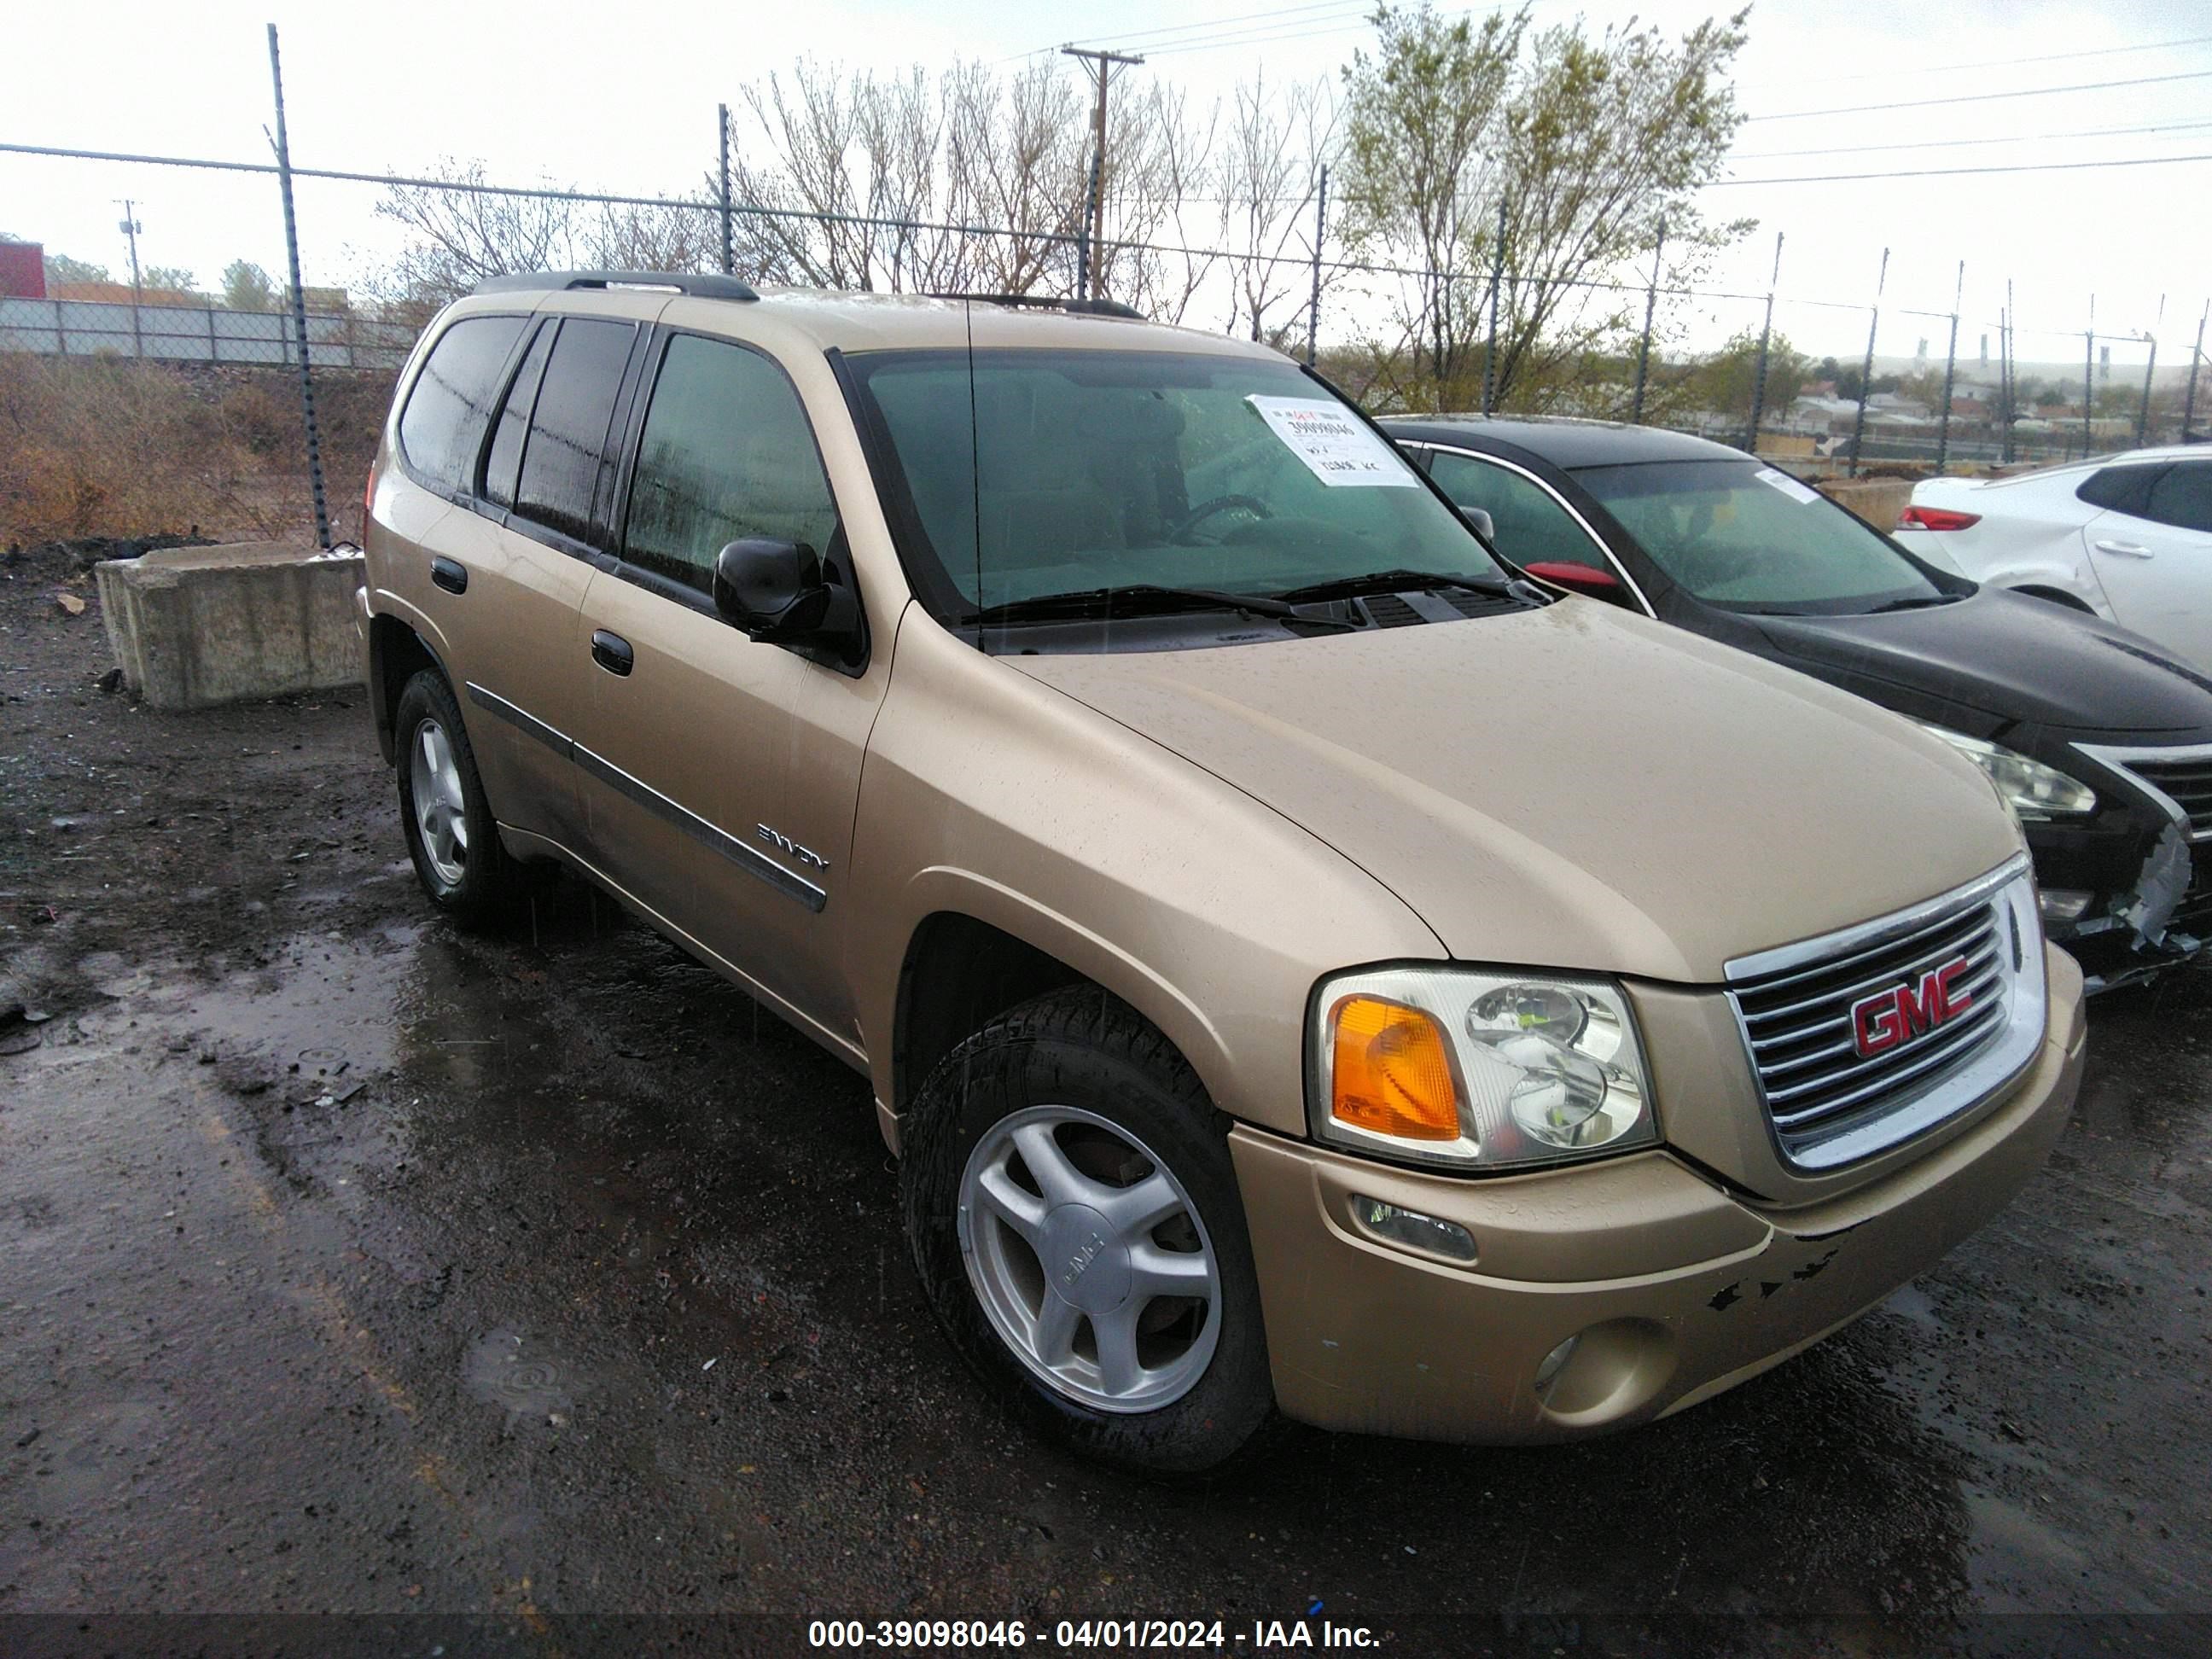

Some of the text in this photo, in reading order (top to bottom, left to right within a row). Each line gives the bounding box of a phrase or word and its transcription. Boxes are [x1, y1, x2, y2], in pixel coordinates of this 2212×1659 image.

[1288, 421, 1355, 436] 39098046
[757, 823, 830, 873] ENVOY
[1850, 953, 1974, 1059] GMC
[1063, 1232, 1105, 1285] GMC
